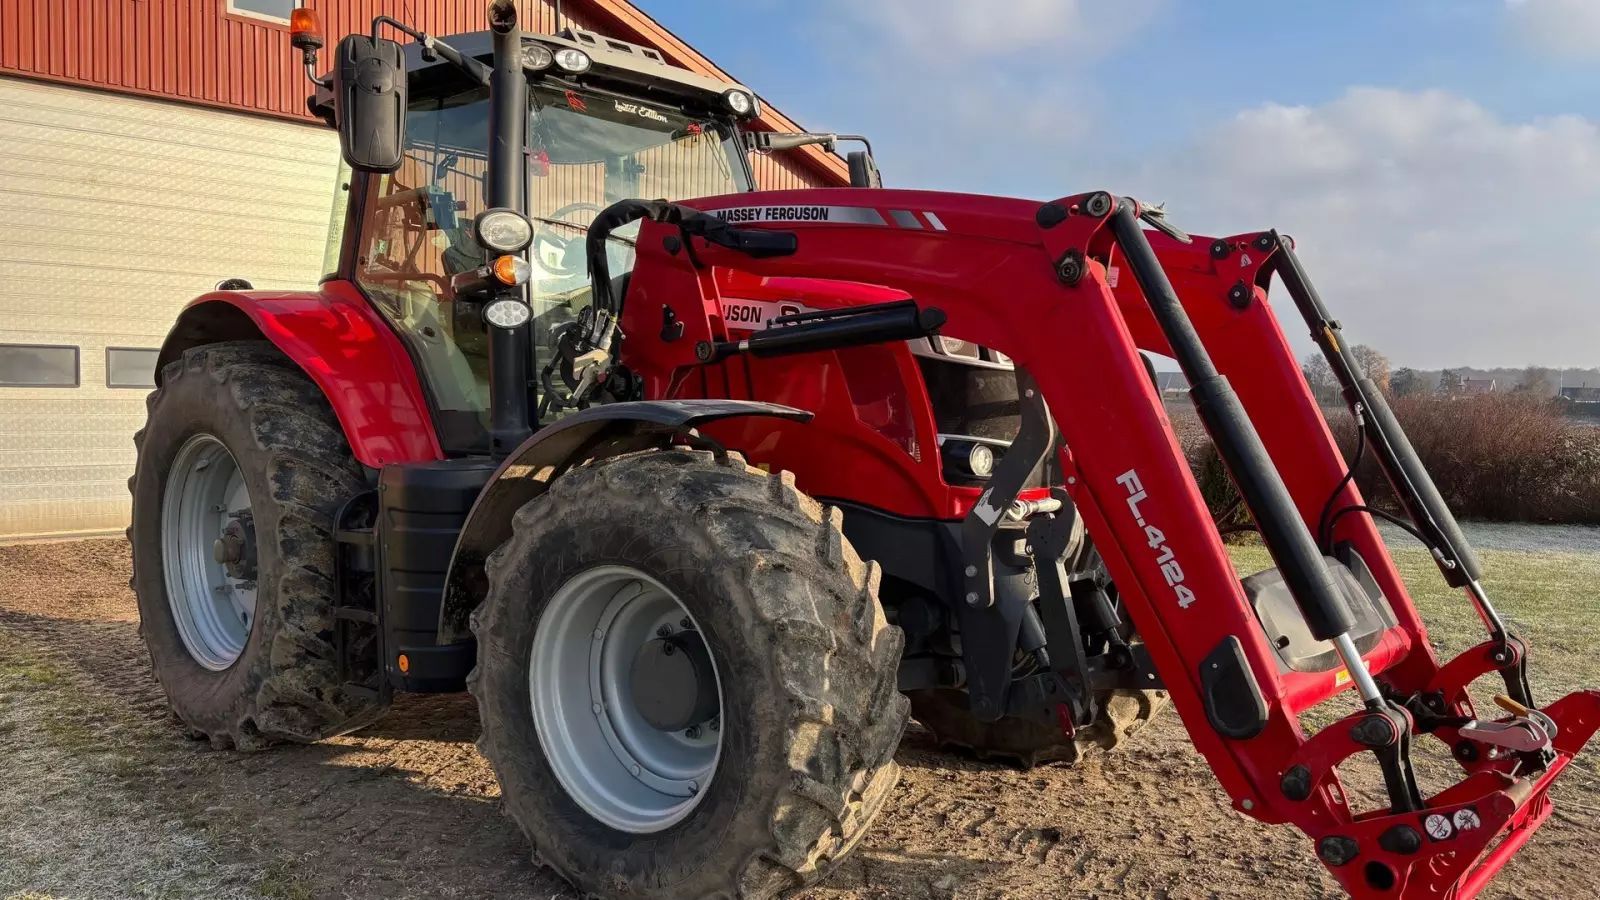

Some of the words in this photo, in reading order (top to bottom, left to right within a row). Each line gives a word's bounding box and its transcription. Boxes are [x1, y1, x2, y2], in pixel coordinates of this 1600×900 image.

[717, 207, 762, 222] MASSEY
[765, 206, 829, 221] FERGUSON
[1115, 468, 1197, 609] FL.4124
